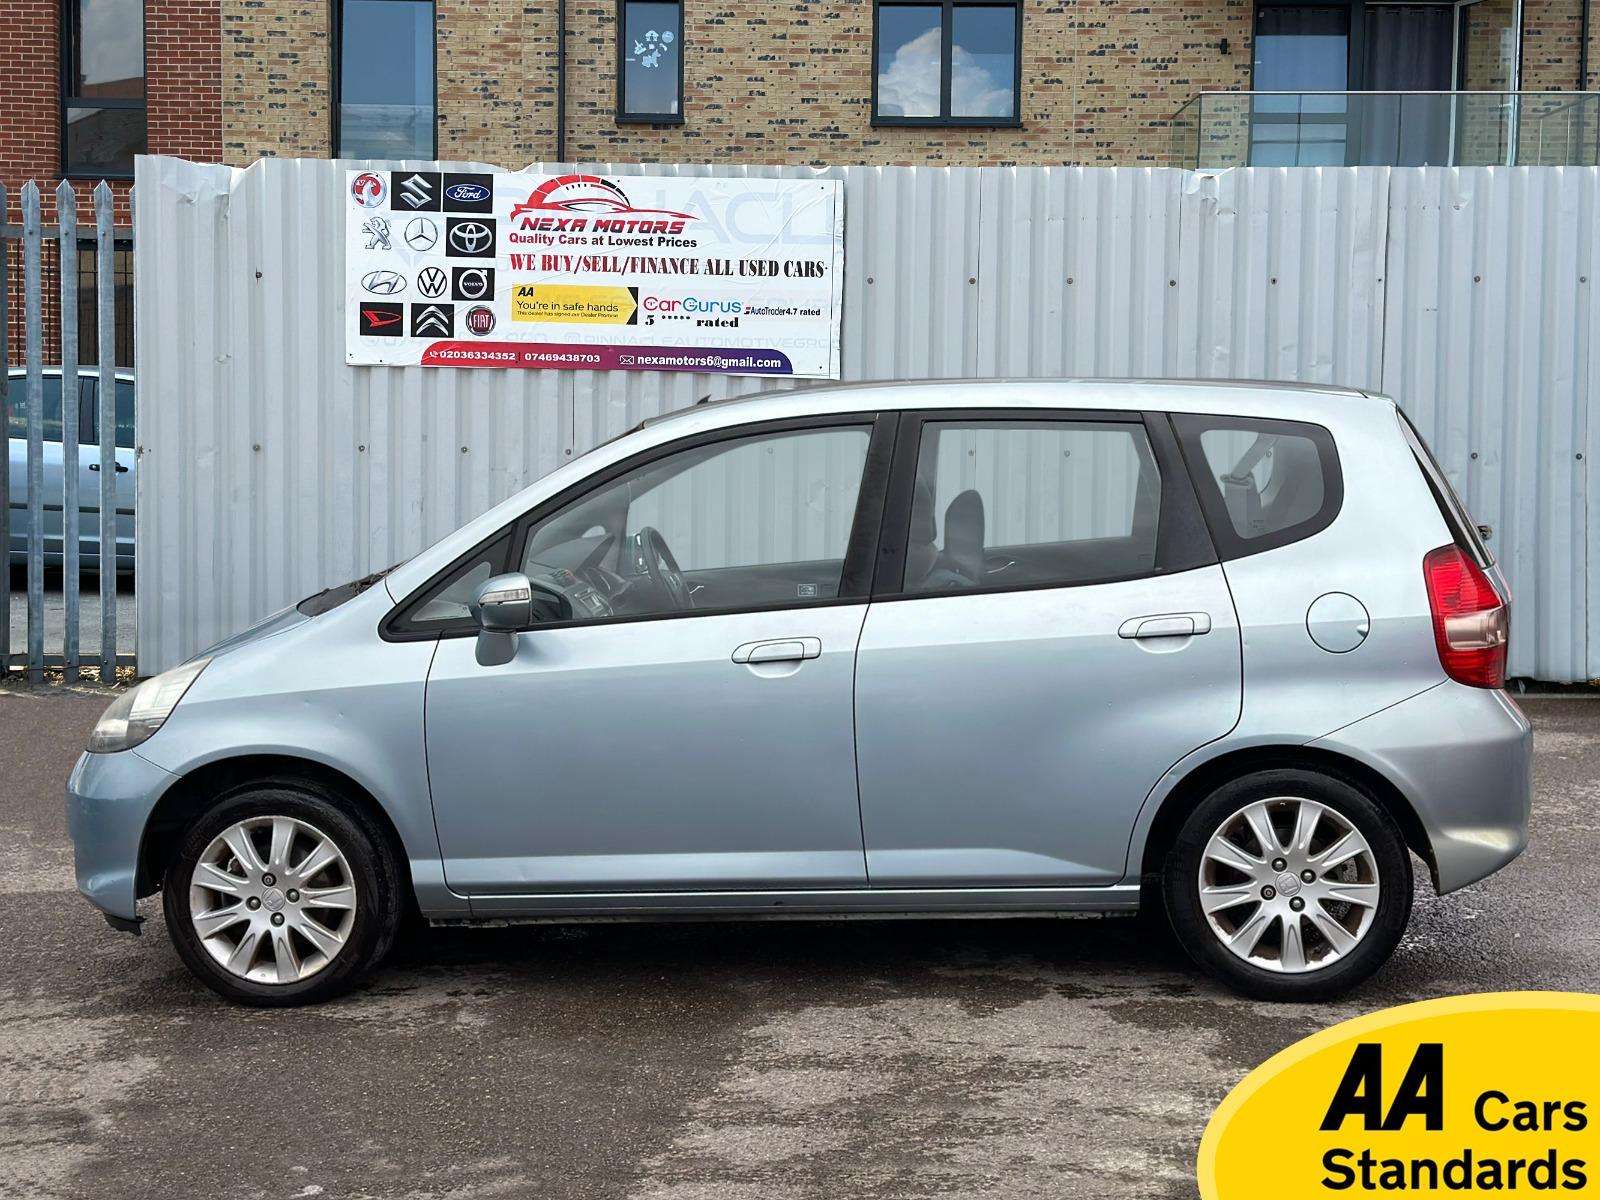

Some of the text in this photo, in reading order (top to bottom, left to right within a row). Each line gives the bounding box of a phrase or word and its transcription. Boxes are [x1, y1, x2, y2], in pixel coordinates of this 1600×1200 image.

[454, 186, 482, 199] Ford
[520, 217, 685, 235] NEXA MOTORS
[509, 232, 698, 248] Quality Cars at Lowest Prices
[508, 253, 536, 271] WE
[703, 258, 734, 276] ALL
[739, 260, 780, 277] USED
[783, 260, 825, 278] CARS
[518, 287, 533, 296] AA
[516, 300, 619, 312] You're in safe hands
[643, 297, 742, 313] CarGurus
[473, 315, 490, 328] FIAT
[645, 315, 739, 328] 5 rated
[440, 350, 781, 370] 02036334352 07469438703 nexamotors6@gmail.com
